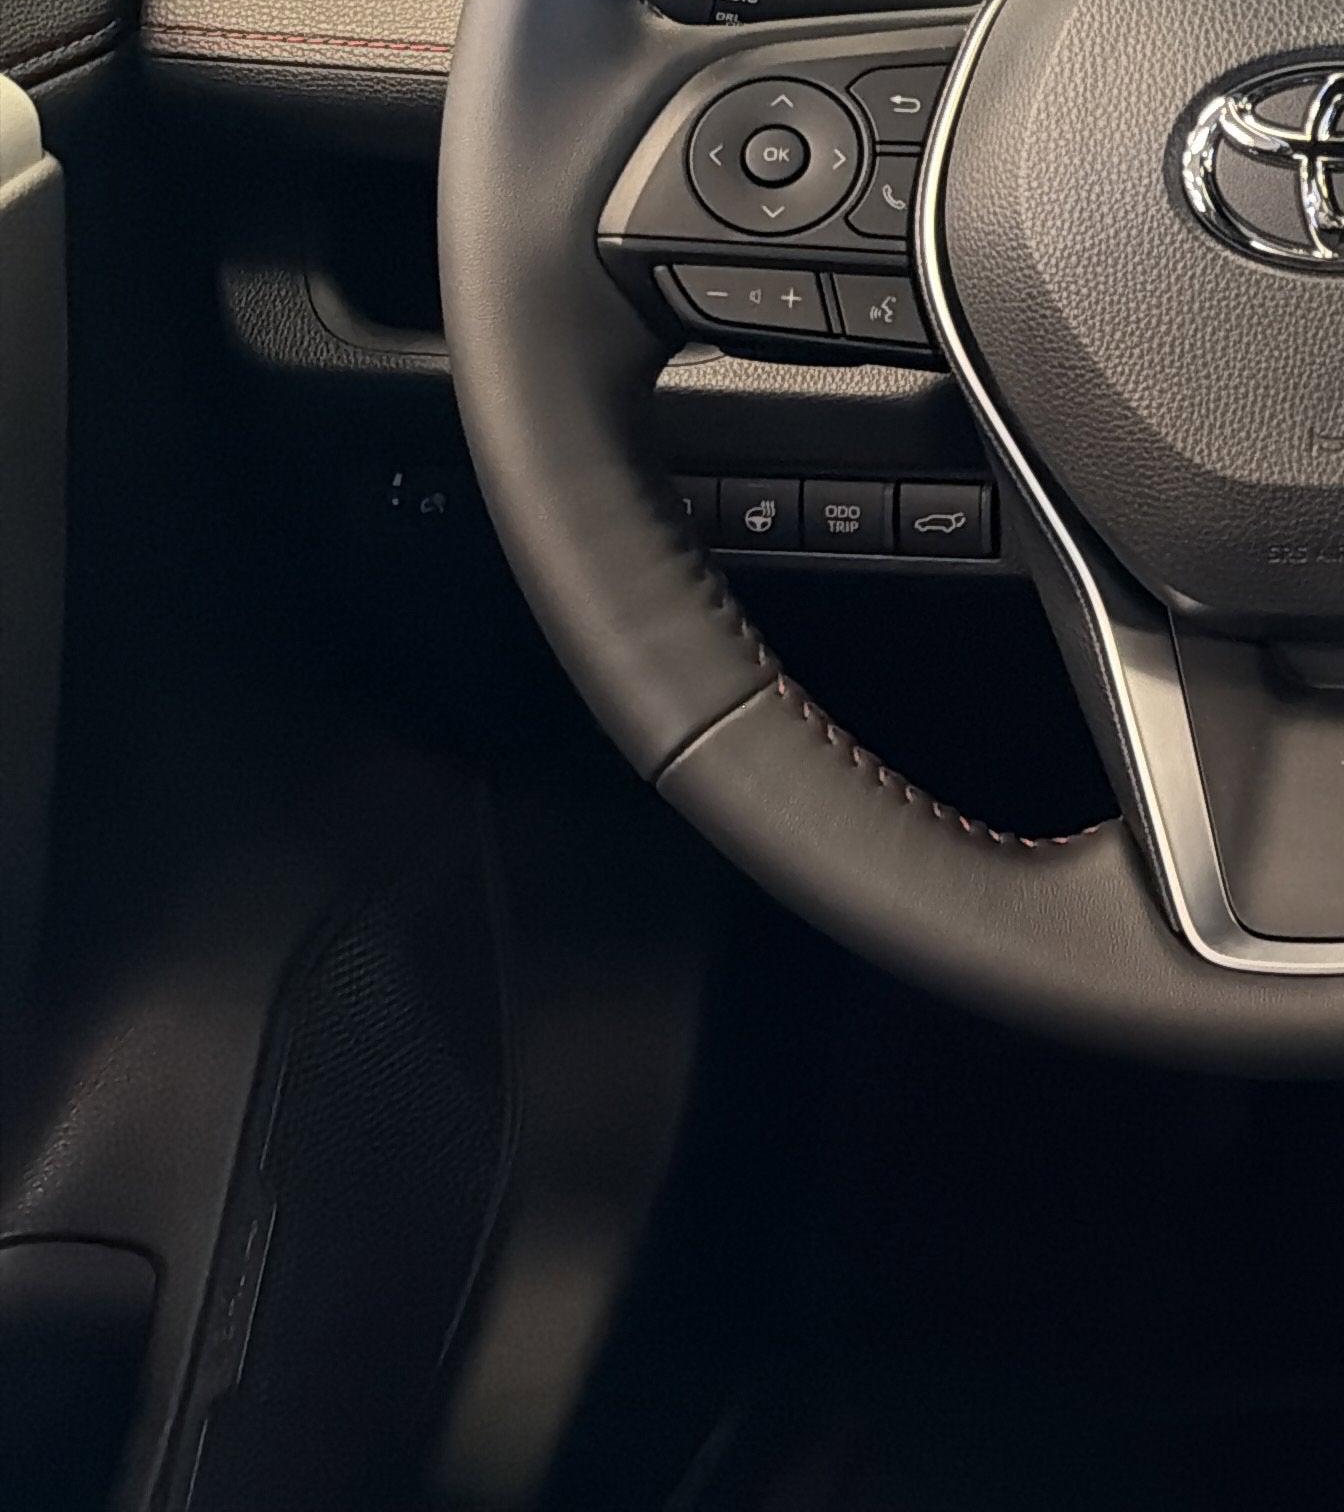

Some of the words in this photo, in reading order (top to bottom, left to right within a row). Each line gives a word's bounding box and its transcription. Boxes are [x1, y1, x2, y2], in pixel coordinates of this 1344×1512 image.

[763, 146, 790, 163] OK
[825, 505, 861, 519] ODO
[827, 519, 860, 533] TRIP
